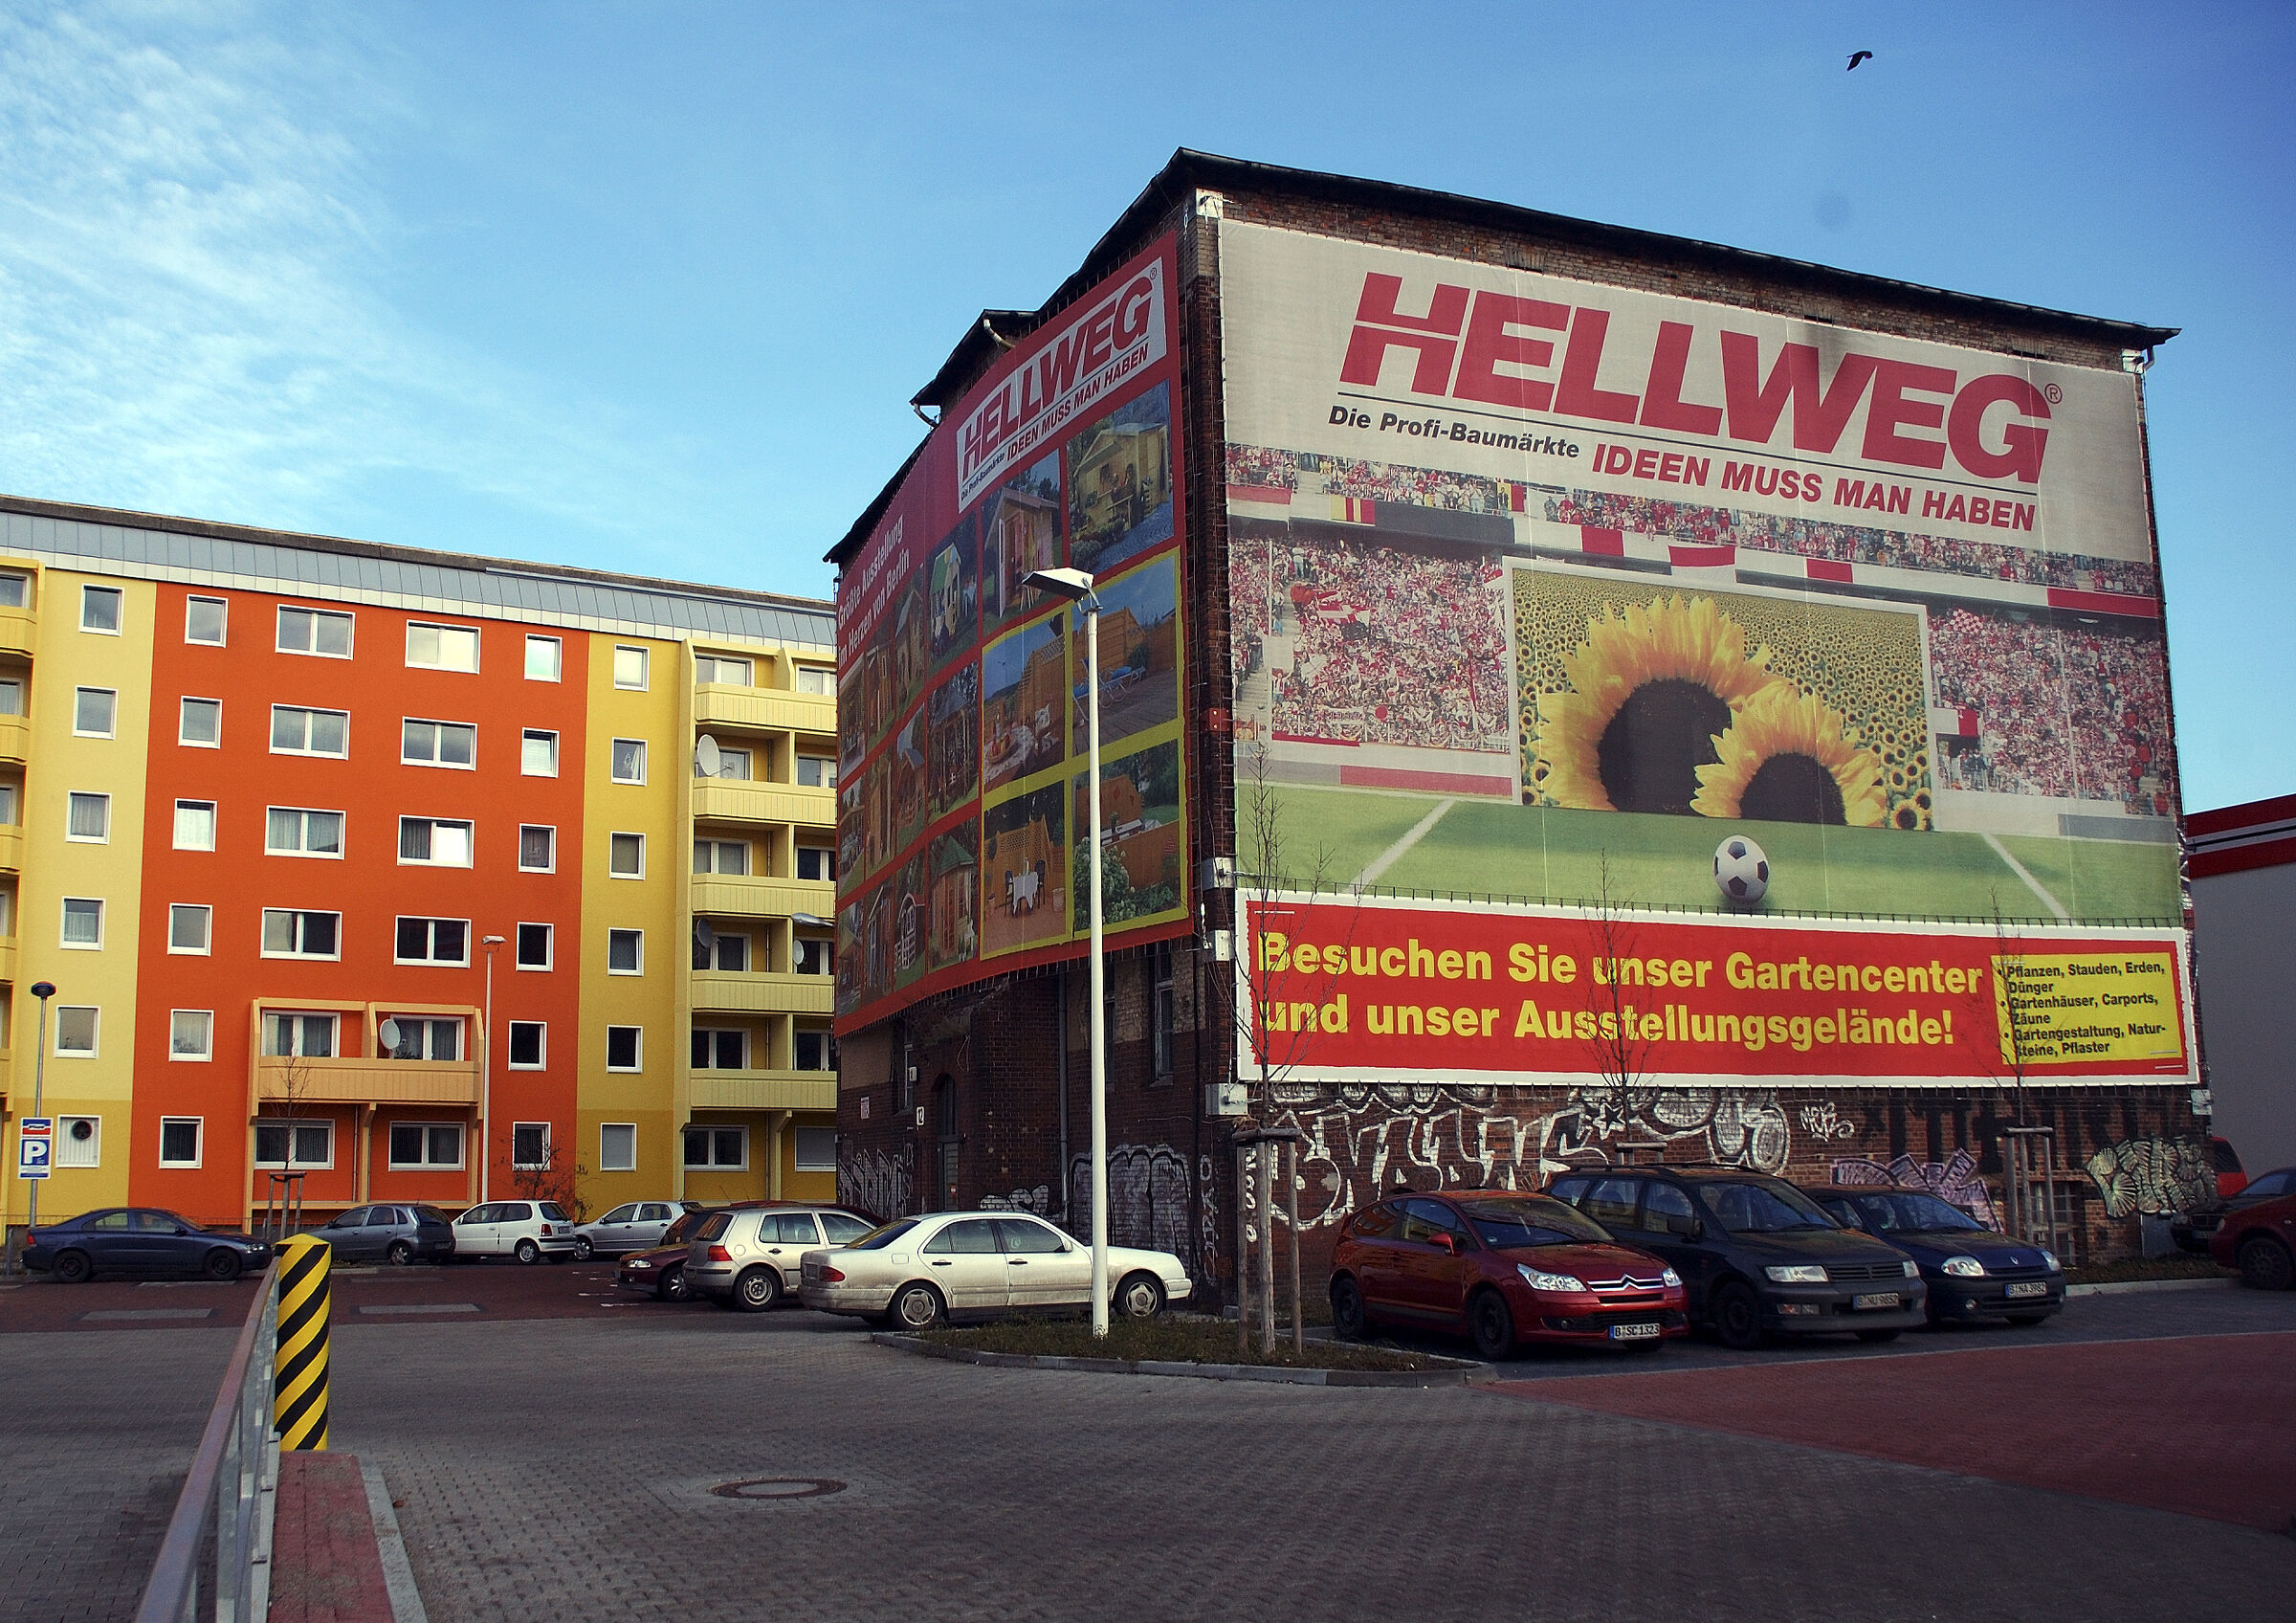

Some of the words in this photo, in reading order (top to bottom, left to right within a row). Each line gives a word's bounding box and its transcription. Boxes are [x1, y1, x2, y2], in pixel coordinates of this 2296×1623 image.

[962, 276, 1154, 481] HELLWEG
[1007, 424, 1039, 460] IDEEN
[1041, 399, 1071, 436] MUSS
[1073, 378, 1101, 411] MAN
[1103, 343, 1149, 389] HABEN
[1338, 271, 2051, 483] HELLWEG
[1328, 405, 1372, 429] Die
[1380, 412, 1579, 458] Profi-Baumärkte
[1592, 443, 1711, 486] IDEEN
[1720, 460, 1823, 502] MUSS
[1833, 478, 1912, 515] MAN
[1921, 491, 2036, 532] HABEN
[838, 585, 861, 631] Größte
[861, 514, 903, 597] Ausstellung
[848, 609, 872, 656] Herzen
[872, 588, 885, 620] von
[886, 547, 910, 600] Berlin
[1257, 931, 1492, 981] Besuchen
[1508, 943, 1577, 984] Sie
[1592, 955, 1712, 988] unser
[1725, 951, 1982, 994] Gartencenter
[2007, 965, 2065, 979] Pflanzen,
[2068, 962, 2122, 976] Stauden,
[2125, 961, 2165, 975] Erden,
[2007, 981, 2054, 996] Dünger
[1258, 993, 1349, 1034] und
[1366, 1004, 1500, 1037] unser
[1513, 999, 1954, 1052] Ausstellungsgelände!
[2010, 994, 2099, 1011] Gartenhäuser,
[2102, 992, 2158, 1008] Carports,
[2012, 1012, 2051, 1027] Zäune
[2014, 1025, 2125, 1042] Gartengestaltung,
[2128, 1023, 2167, 1036] Natur-
[2062, 1041, 2110, 1055] Pflaster
[24, 1141, 47, 1164] P
